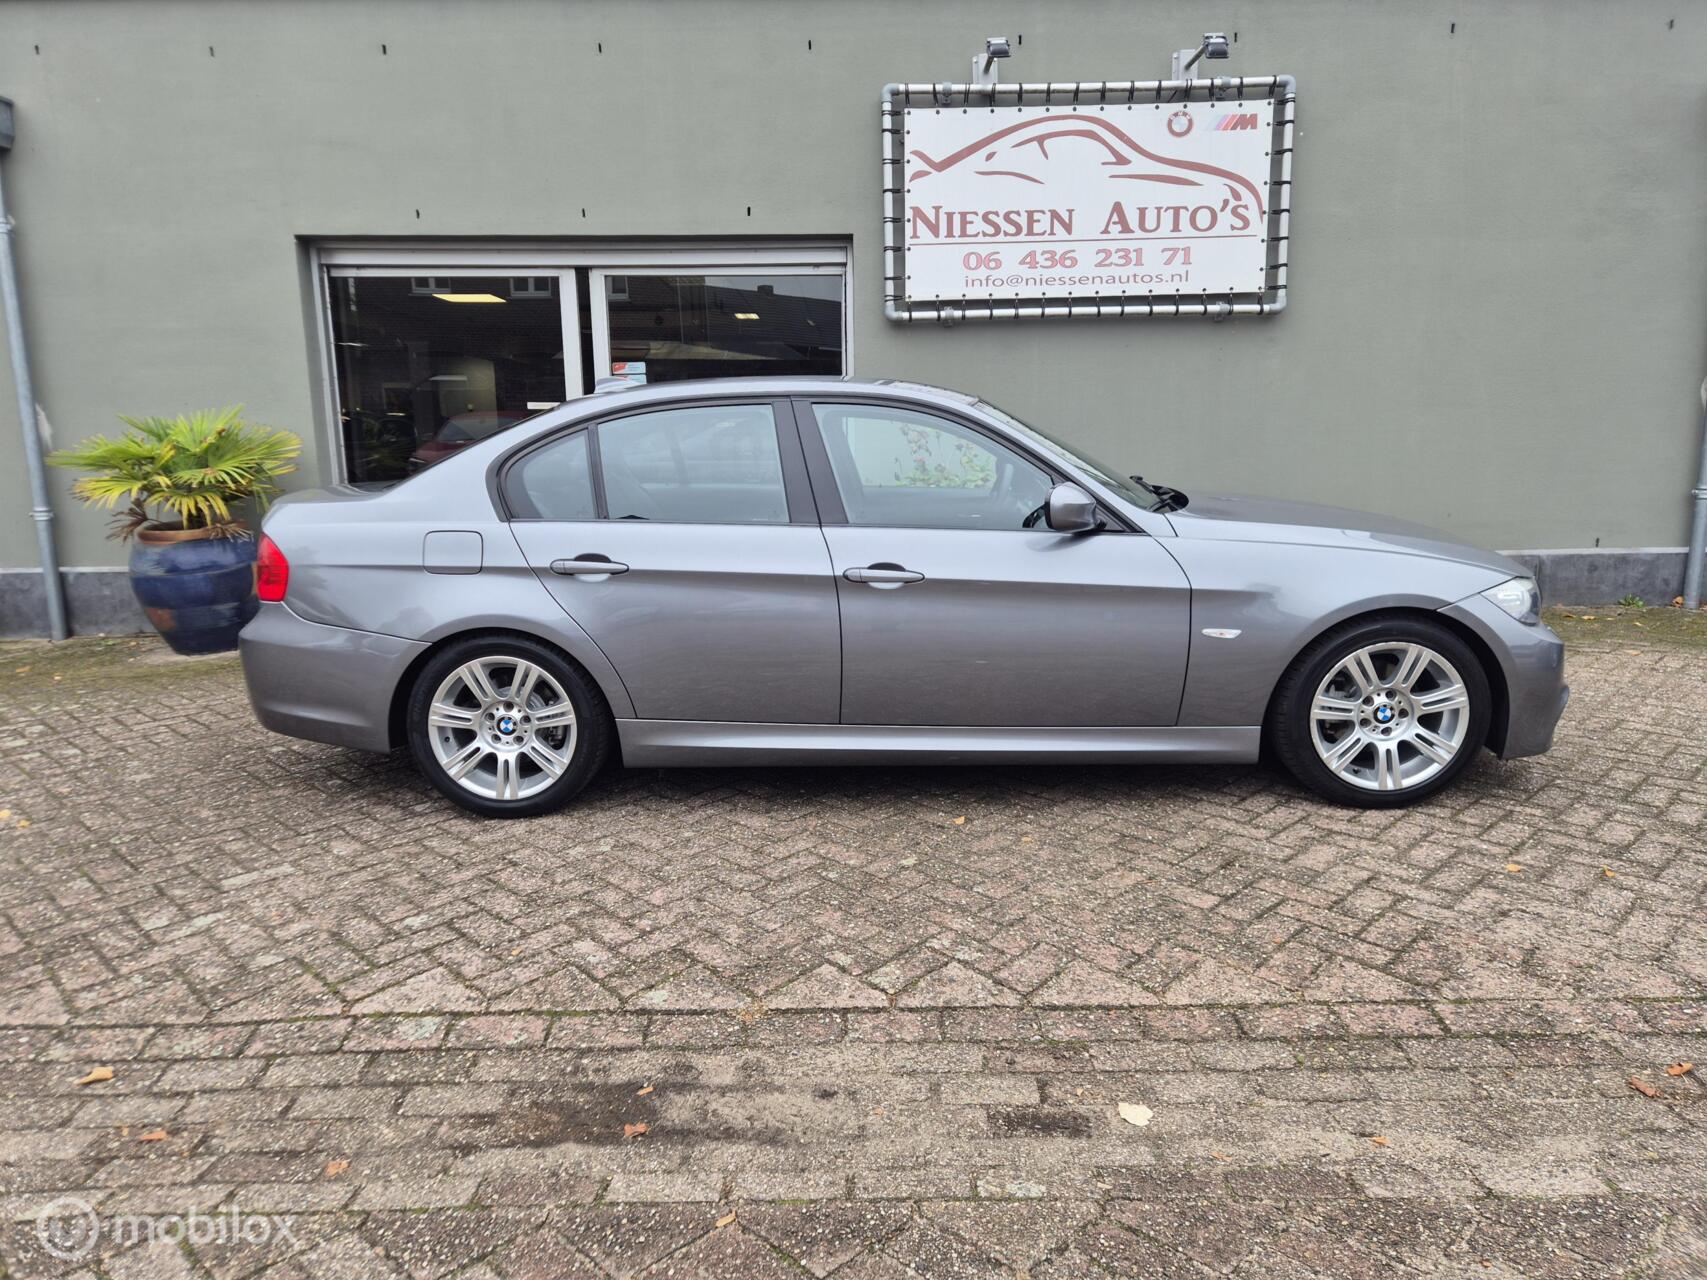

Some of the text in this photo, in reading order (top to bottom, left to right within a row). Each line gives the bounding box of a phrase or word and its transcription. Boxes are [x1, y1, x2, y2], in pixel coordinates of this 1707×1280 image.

[909, 200, 1251, 239] NIESSEN AUTO'S
[962, 246, 1193, 271] 06 436 231 71
[965, 270, 1190, 288] info@niessenautos.nl
